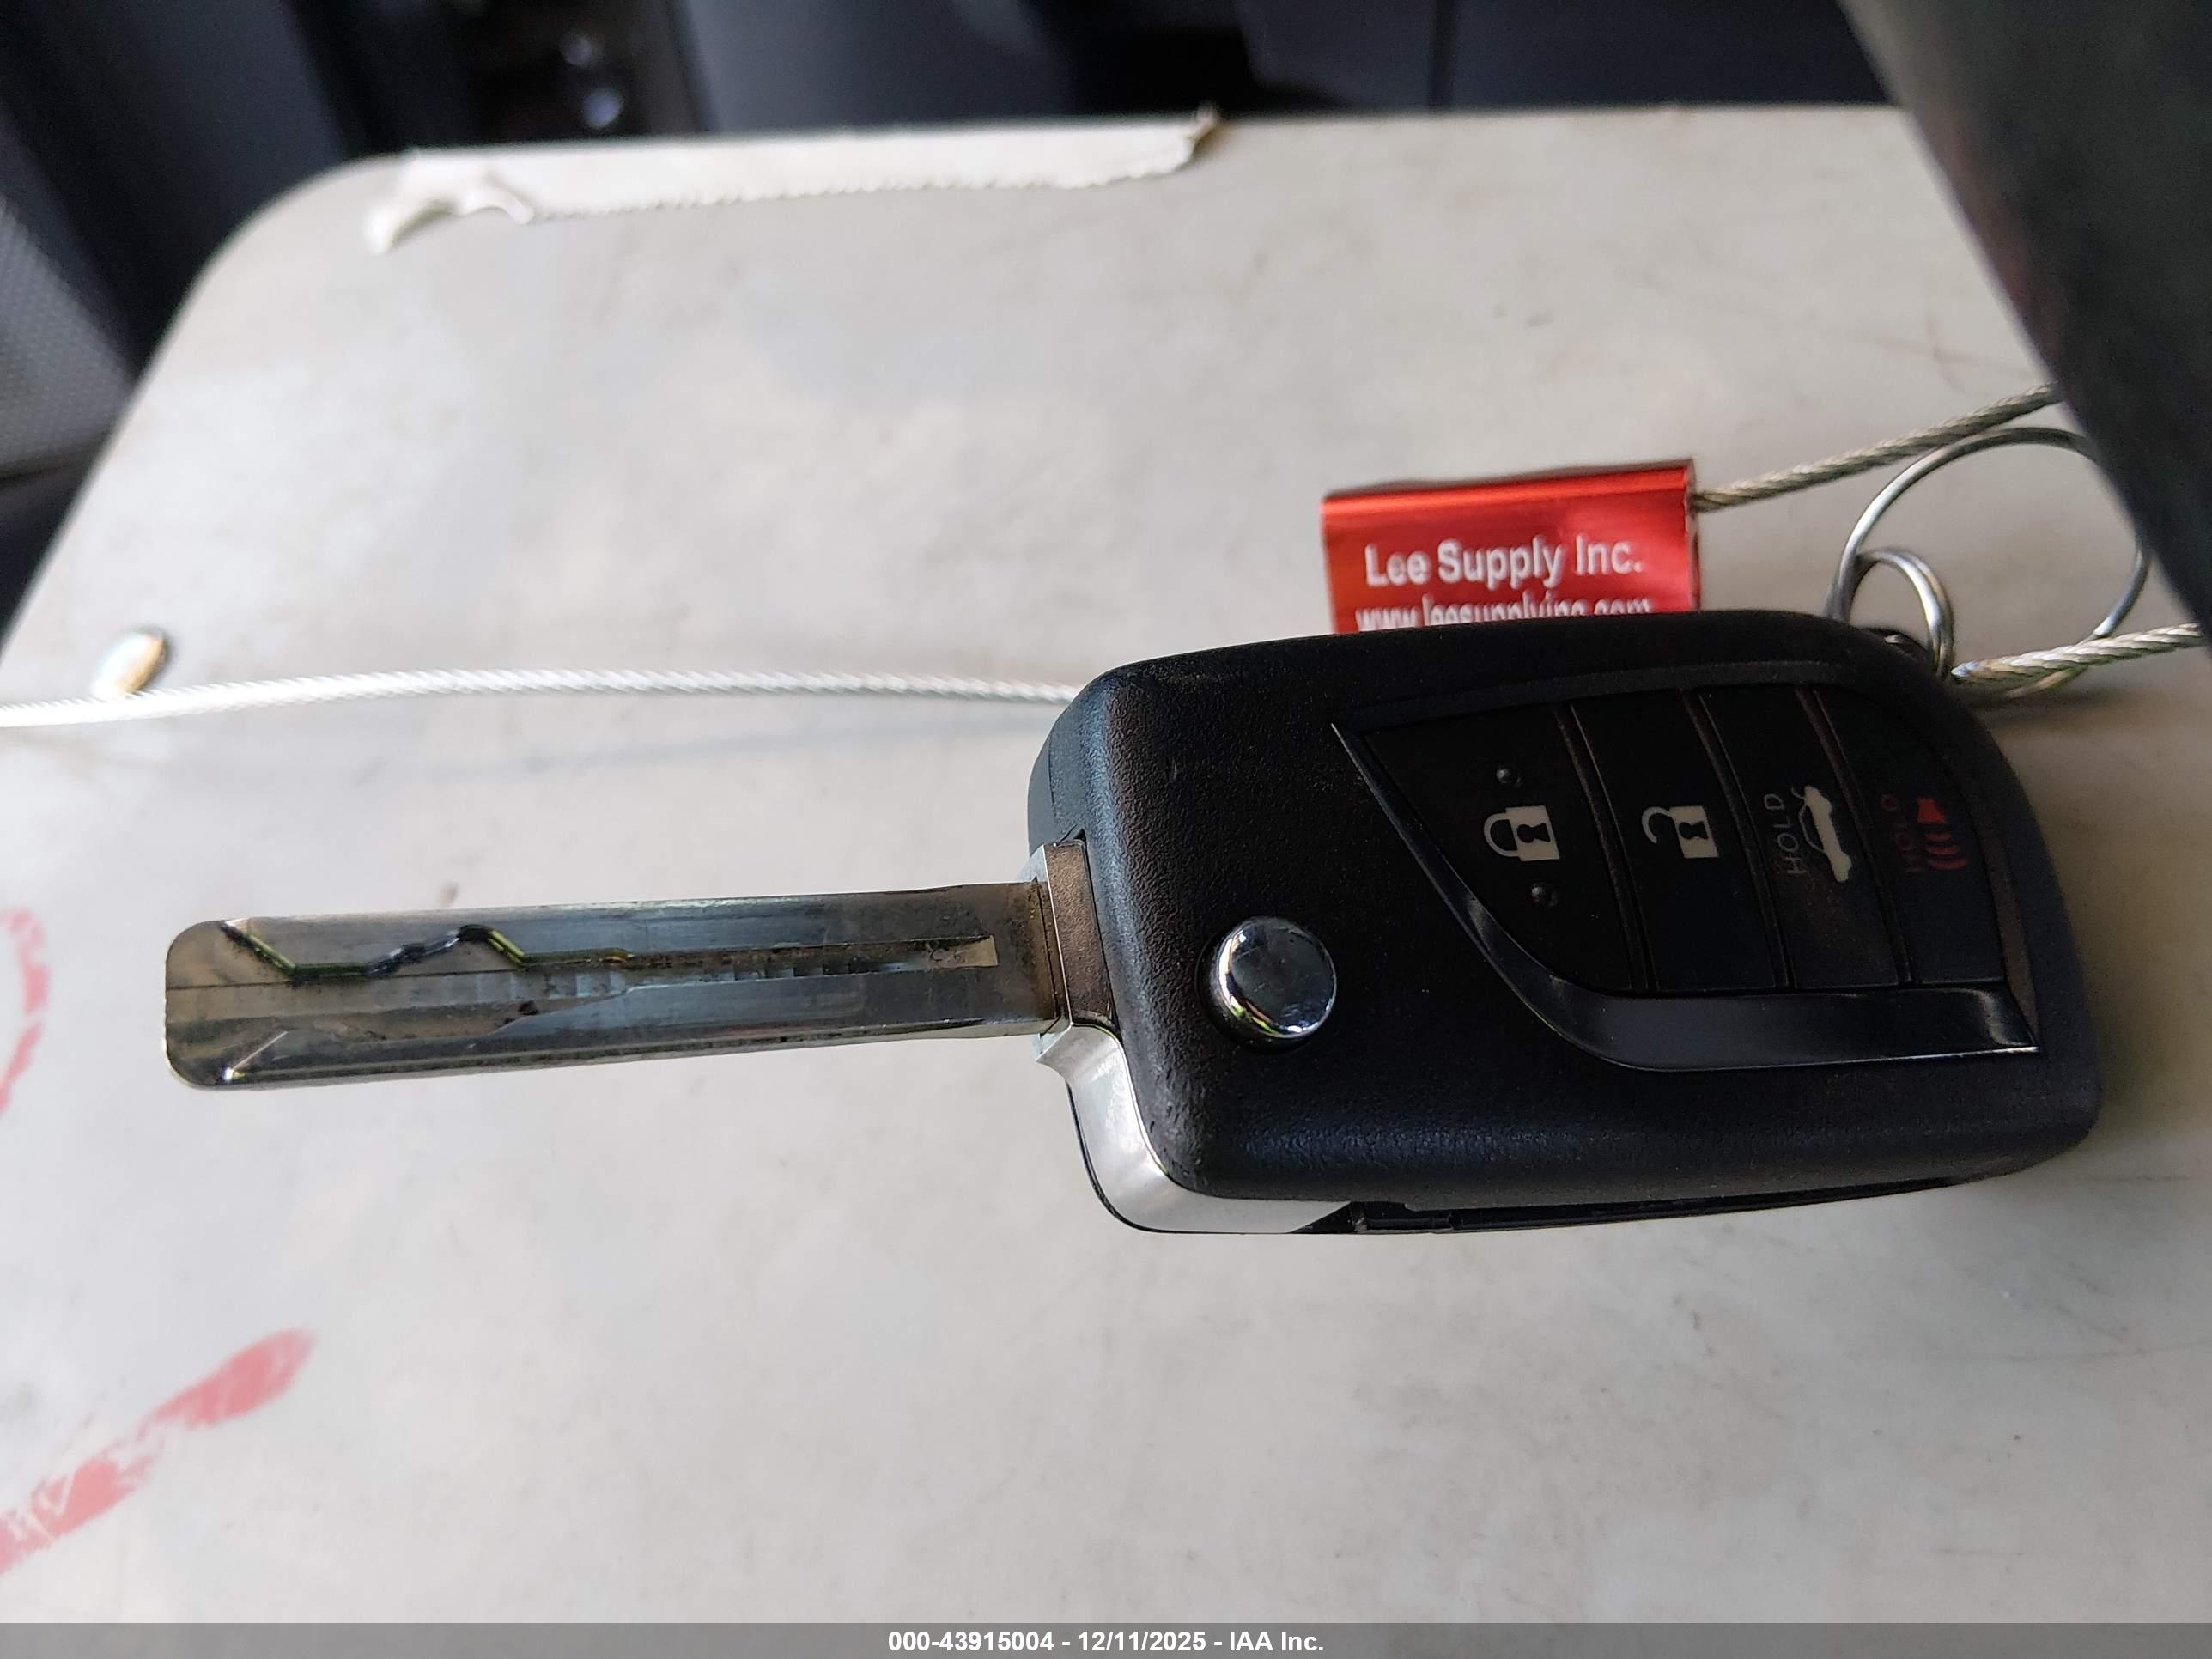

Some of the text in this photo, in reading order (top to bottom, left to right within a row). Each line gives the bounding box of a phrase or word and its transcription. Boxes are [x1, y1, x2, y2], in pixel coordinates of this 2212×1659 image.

[1364, 533, 1642, 590] Lee Supply Inc.
[1764, 793, 1807, 874] HOLD
